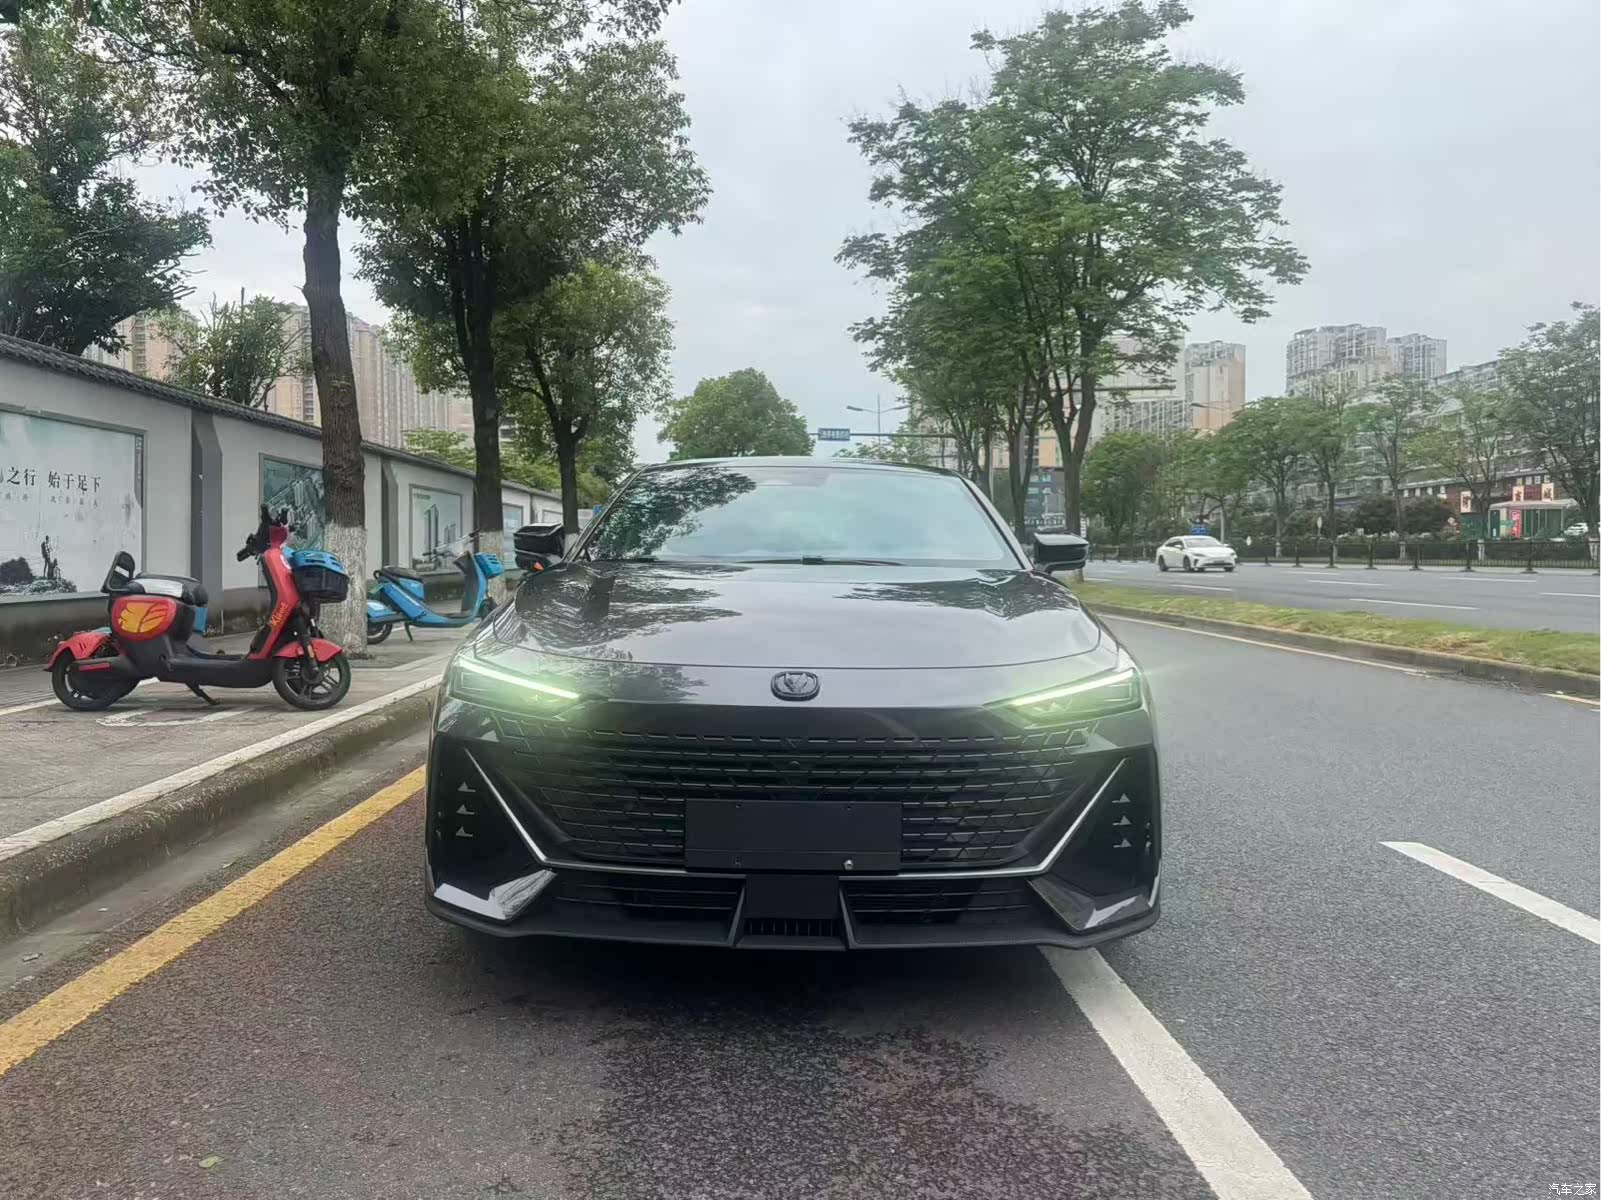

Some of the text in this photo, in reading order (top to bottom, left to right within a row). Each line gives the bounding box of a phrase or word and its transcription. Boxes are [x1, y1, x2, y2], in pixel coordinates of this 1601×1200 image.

[0, 466, 101, 493] 之行 始于足下
